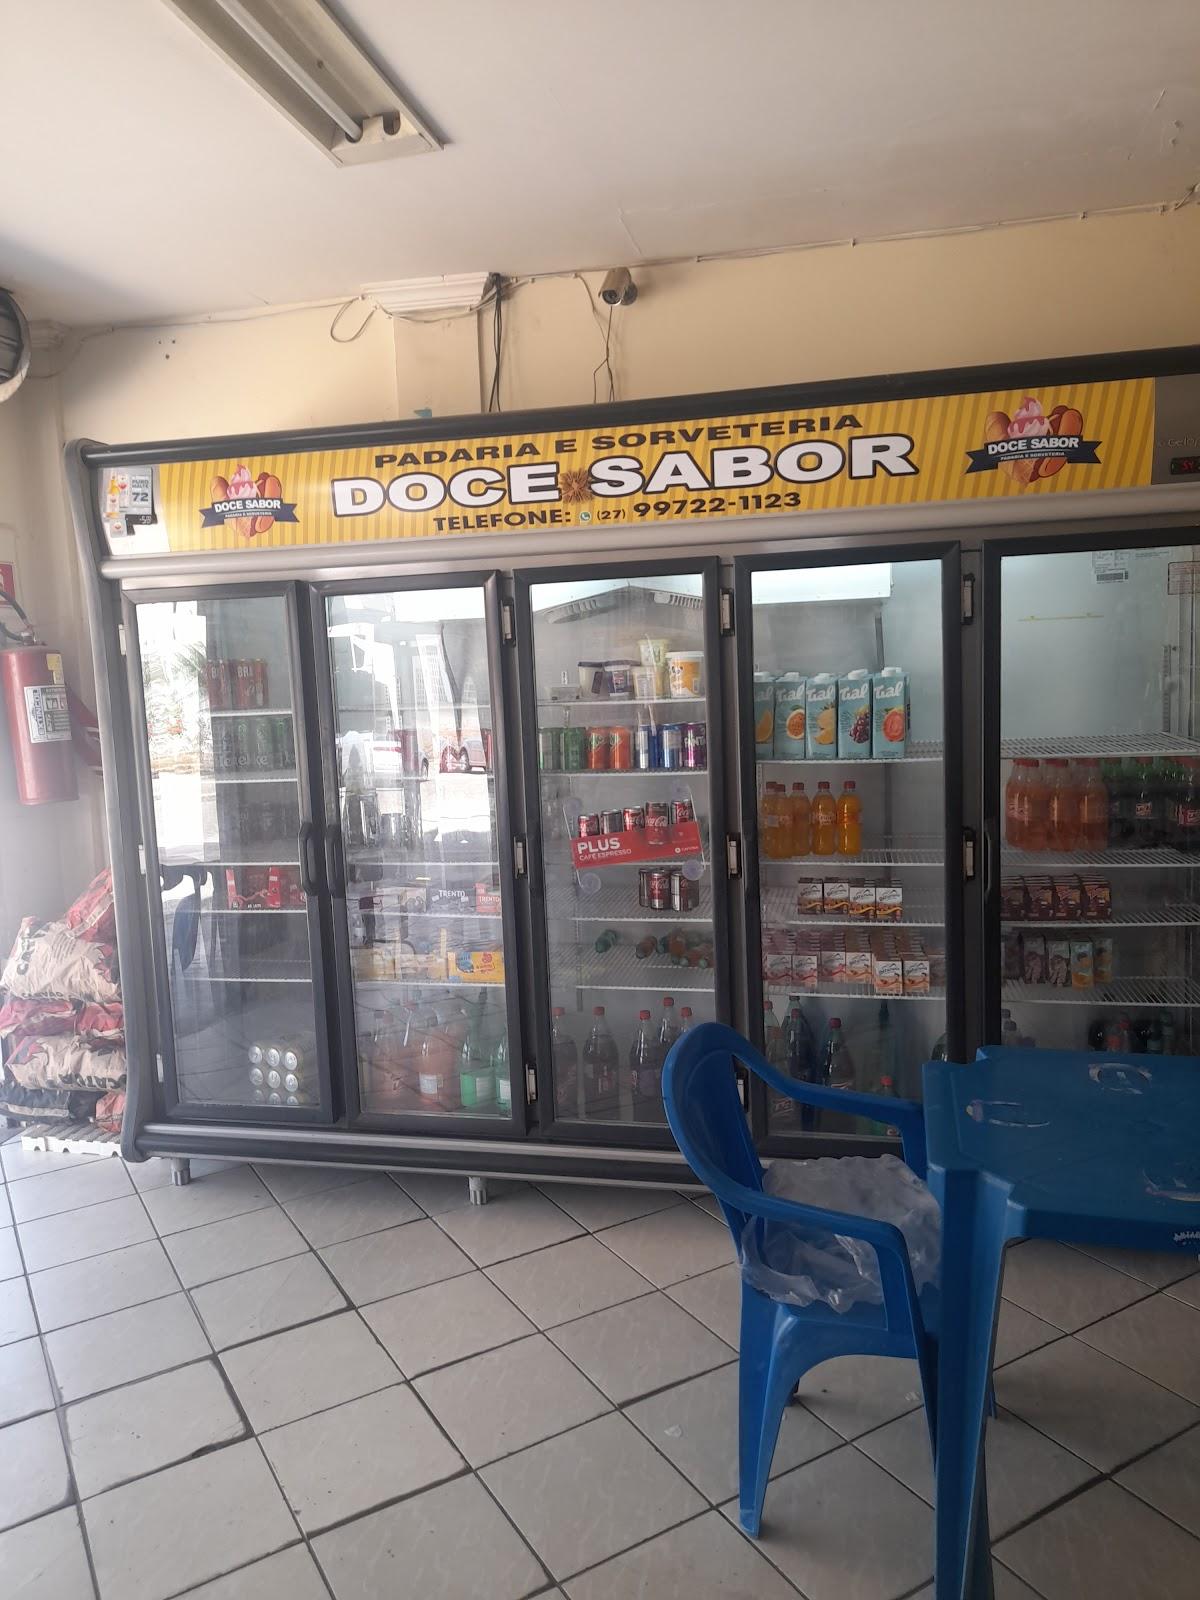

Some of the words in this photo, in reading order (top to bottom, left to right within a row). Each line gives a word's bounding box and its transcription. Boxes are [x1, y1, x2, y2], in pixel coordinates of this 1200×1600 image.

[375, 442, 541, 468] PADARIA
[554, 439, 577, 454] E
[591, 414, 864, 450] SORVETERIA
[987, 439, 1028, 455] DOCE
[1030, 437, 1079, 449] SABOR
[331, 461, 562, 517] DOCE
[588, 433, 920, 498] SABOR
[132, 492, 149, 502] 72
[214, 501, 243, 513] DOCE
[246, 499, 281, 510] SABOR
[433, 509, 571, 532] TELEFONE:
[596, 508, 626, 521] (27)
[633, 492, 801, 518] 99722-1123
[577, 837, 620, 854] PLUS
[438, 889, 465, 898] TRENTO
